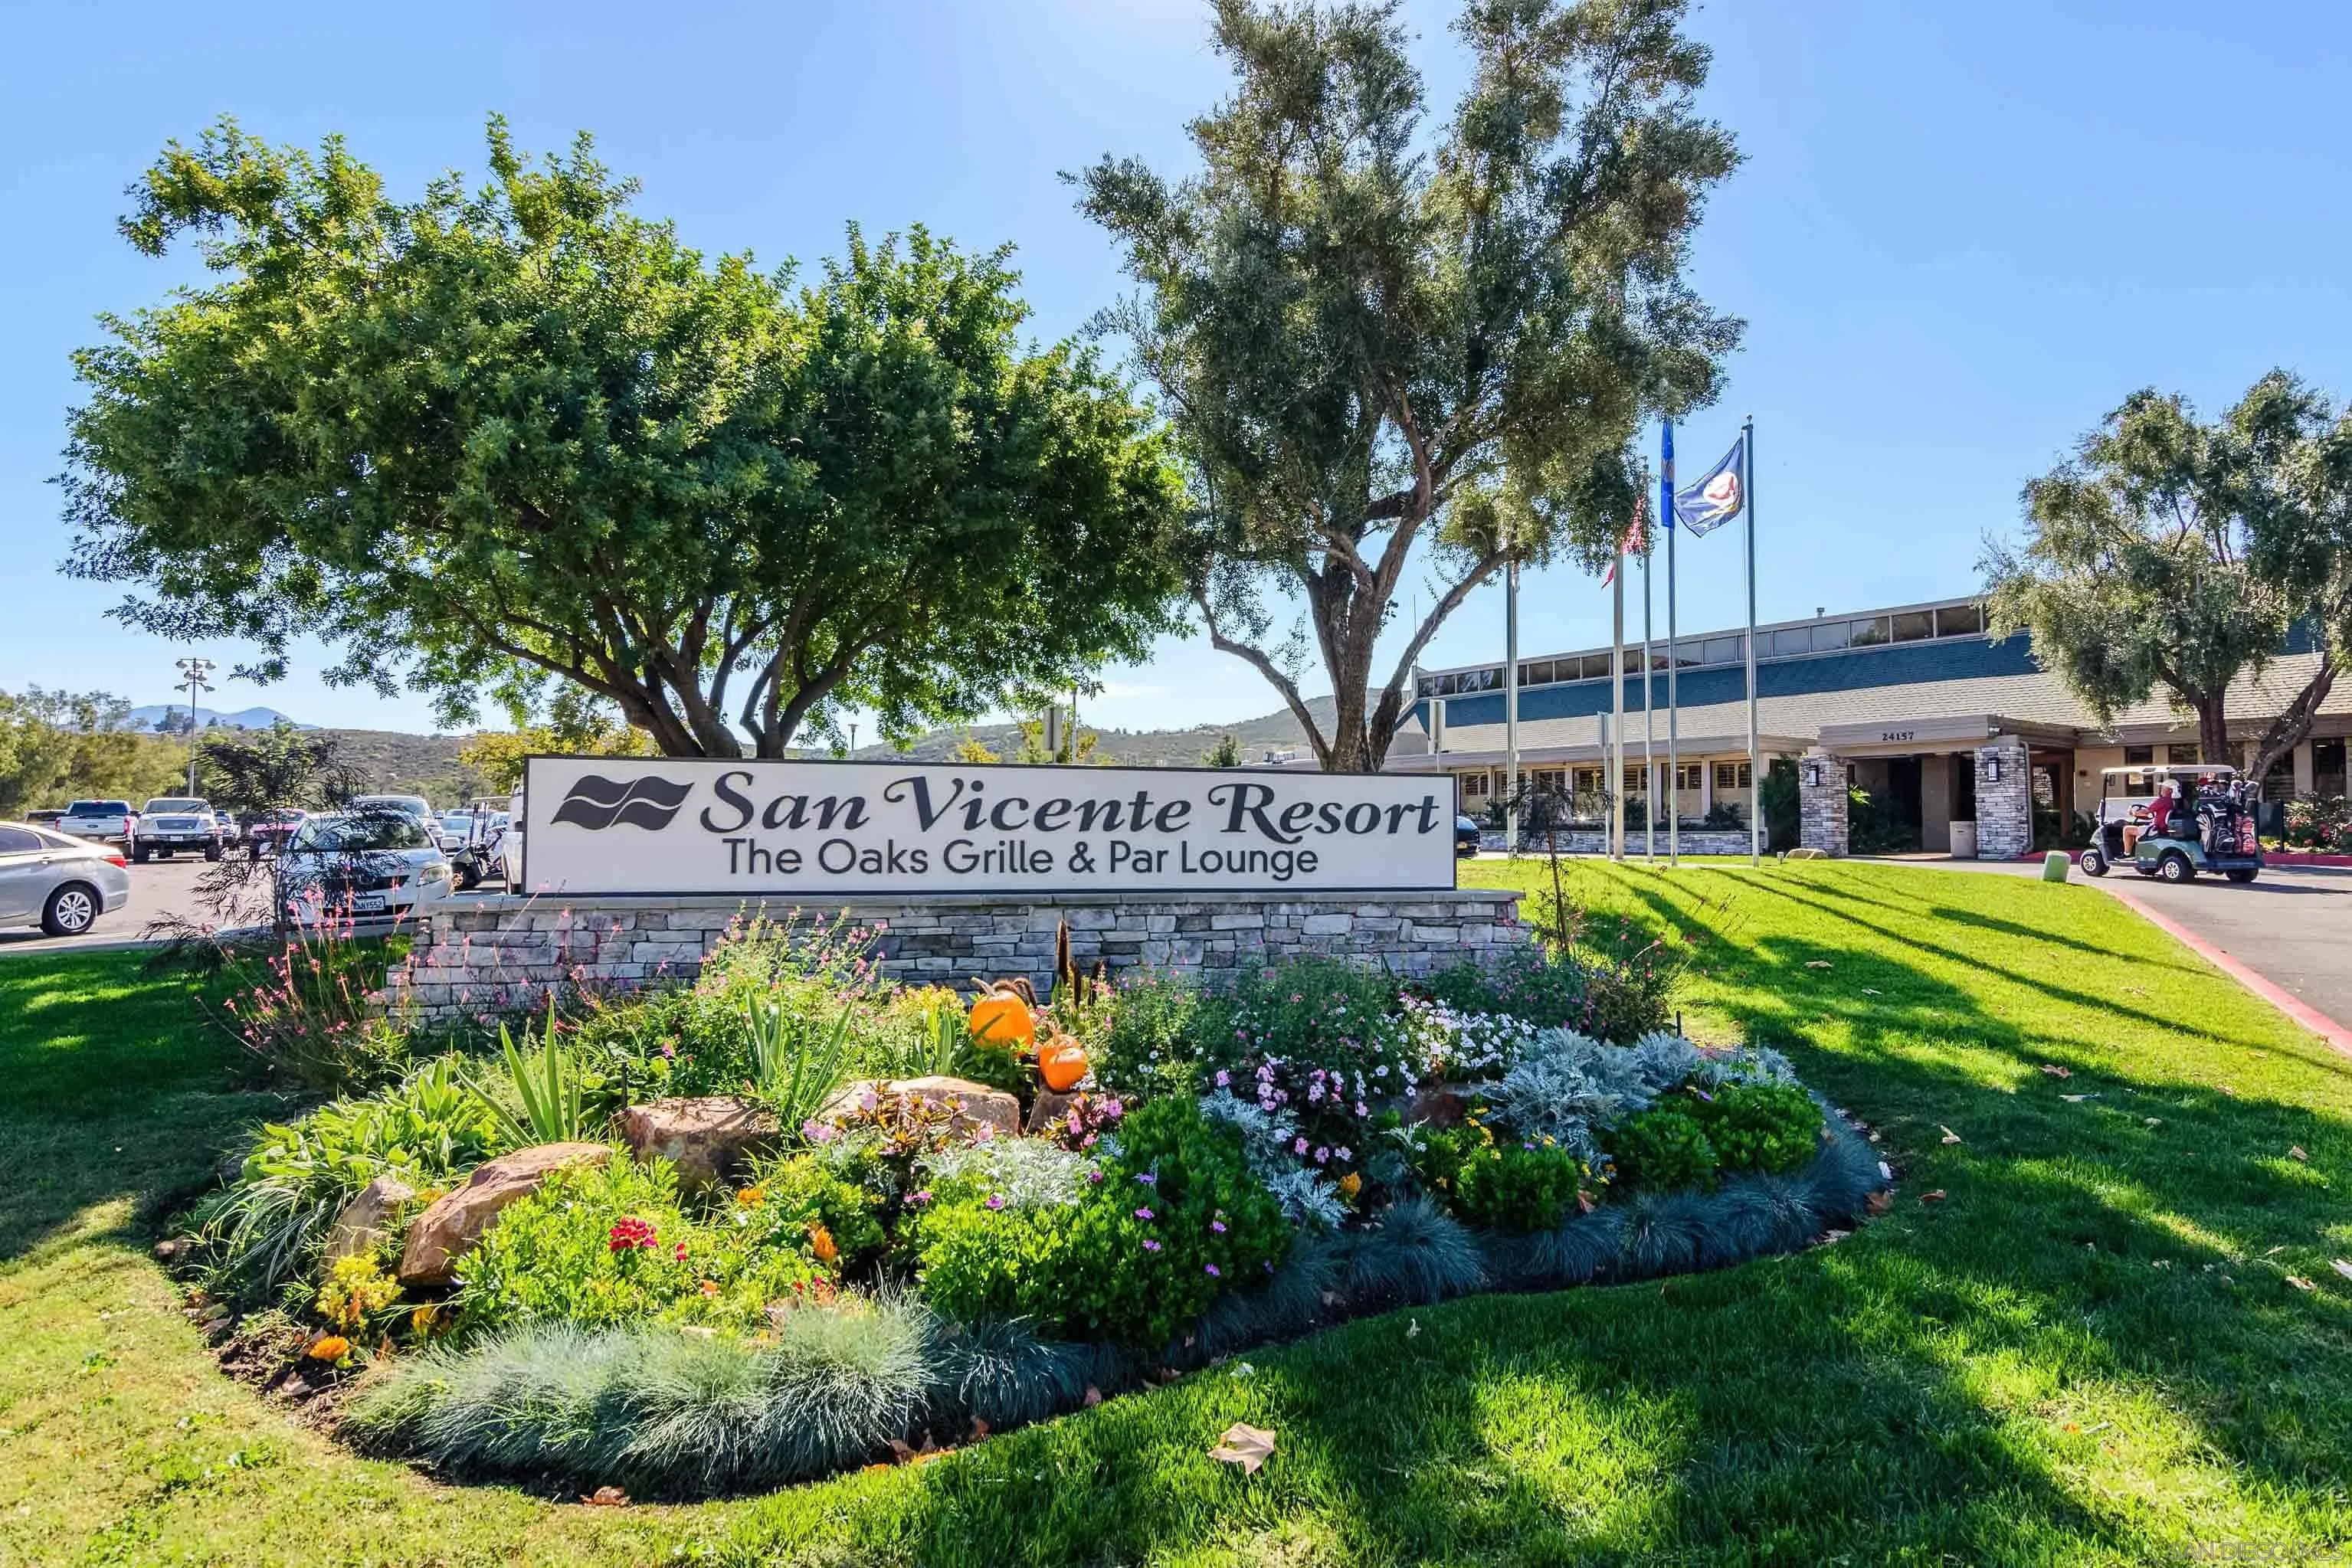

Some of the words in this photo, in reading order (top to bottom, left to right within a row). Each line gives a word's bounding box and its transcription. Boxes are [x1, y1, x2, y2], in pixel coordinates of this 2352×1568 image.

[1882, 732, 1915, 741] 24157
[699, 771, 870, 833] San
[883, 776, 1192, 833] Vicente
[1207, 783, 1440, 844] Resort
[722, 838, 803, 874] The
[817, 838, 929, 875] Oaks
[943, 839, 1054, 875] Grille
[1068, 840, 1096, 874] &
[1109, 840, 1169, 874] Par
[1181, 840, 1318, 882] Lounge
